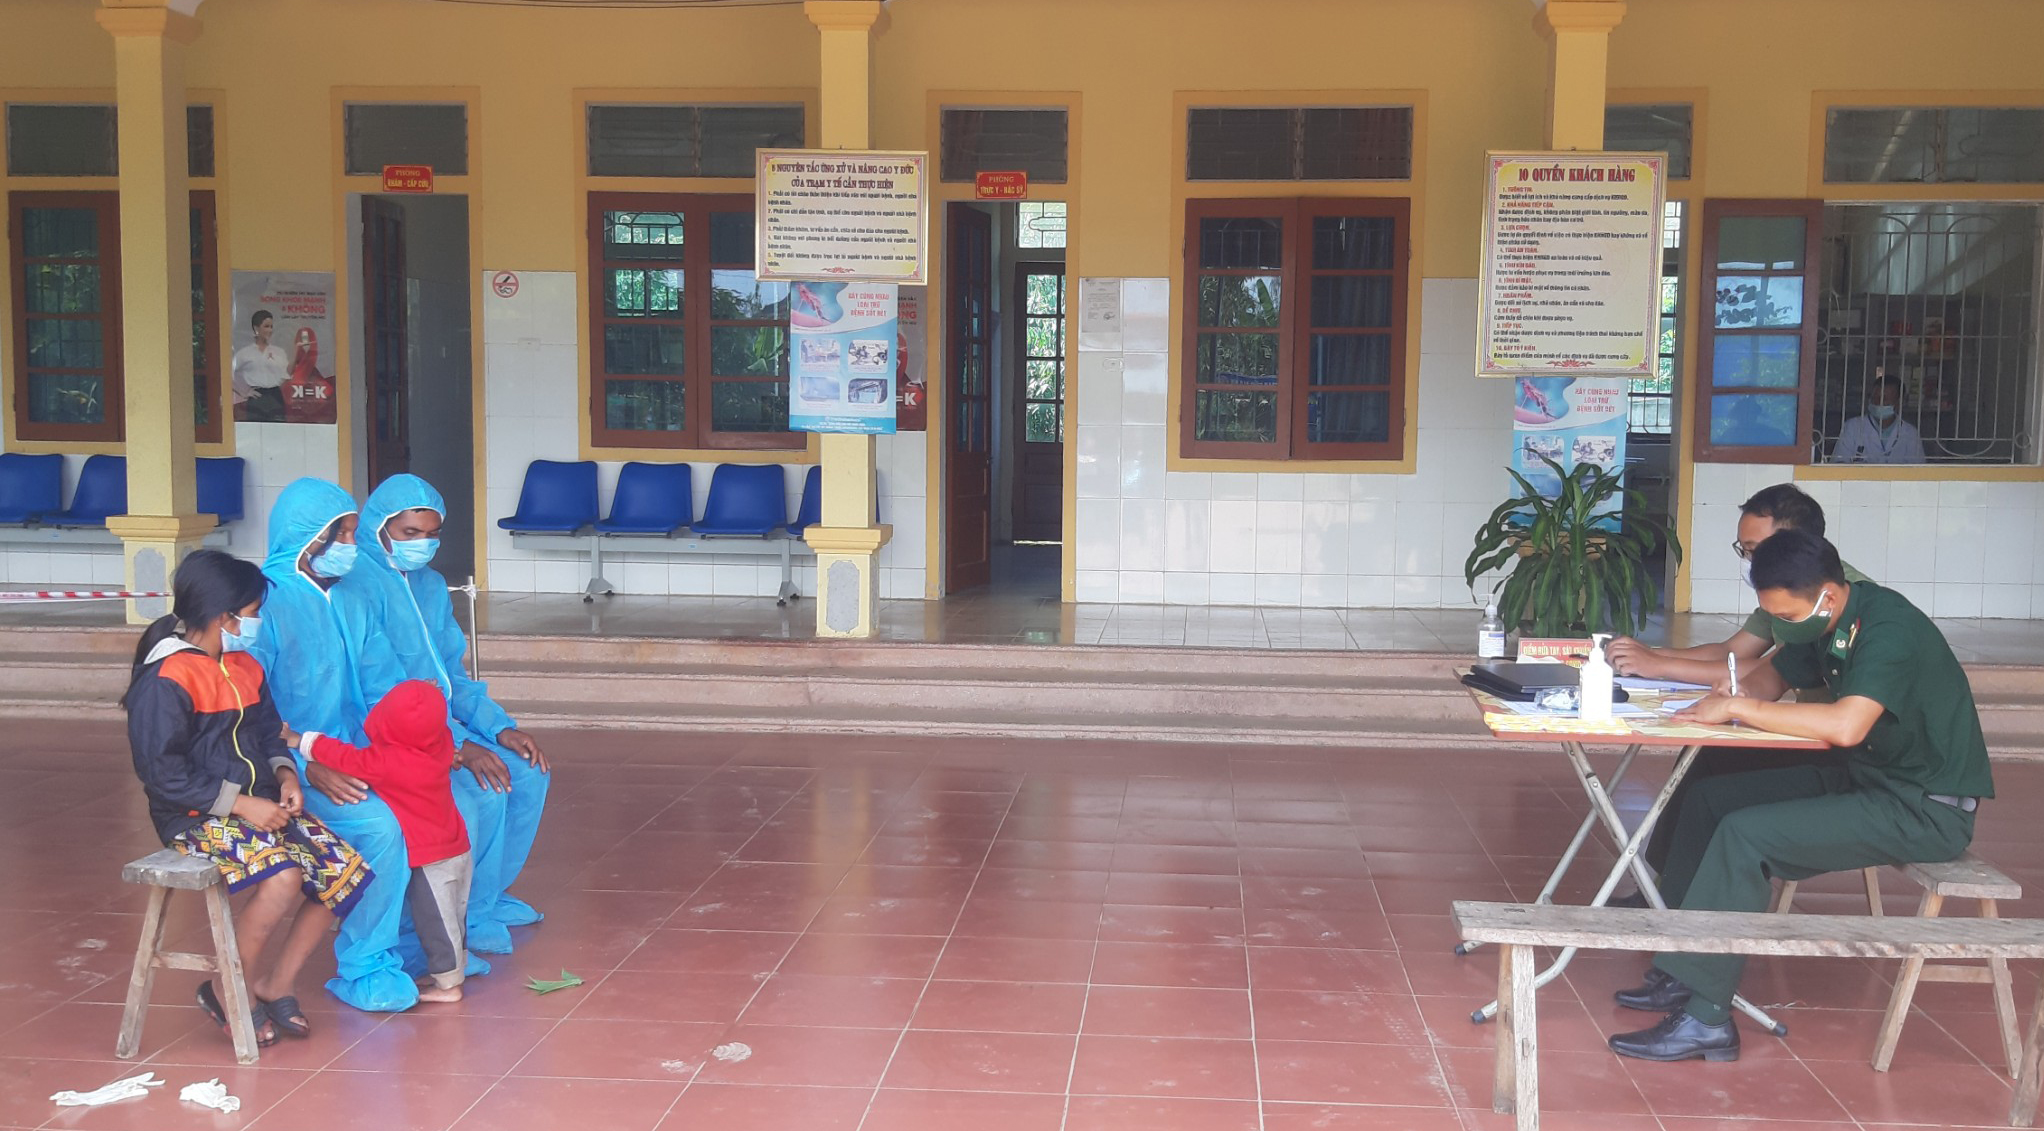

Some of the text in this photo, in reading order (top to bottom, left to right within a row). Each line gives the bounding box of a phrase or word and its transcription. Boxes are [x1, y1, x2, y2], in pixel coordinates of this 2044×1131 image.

[776, 162, 805, 172] NGUYÊN
[806, 160, 820, 172] TẮC
[821, 162, 834, 172] ỨNG
[836, 162, 846, 173] XỬ
[847, 163, 856, 174] VÀ
[858, 162, 878, 174] NÂNG
[878, 166, 892, 174] CAO
[894, 166, 900, 174] Y
[900, 164, 914, 174] ĐỨC
[1519, 164, 1636, 182] 10 QUYỀN KHÁCH HÀNG
[388, 178, 402, 187] KHÁM
[408, 179, 417, 188] CẤP
[792, 176, 894, 190] CỦA TRẠM Y TẾ CẦN THỰC HIỆN
